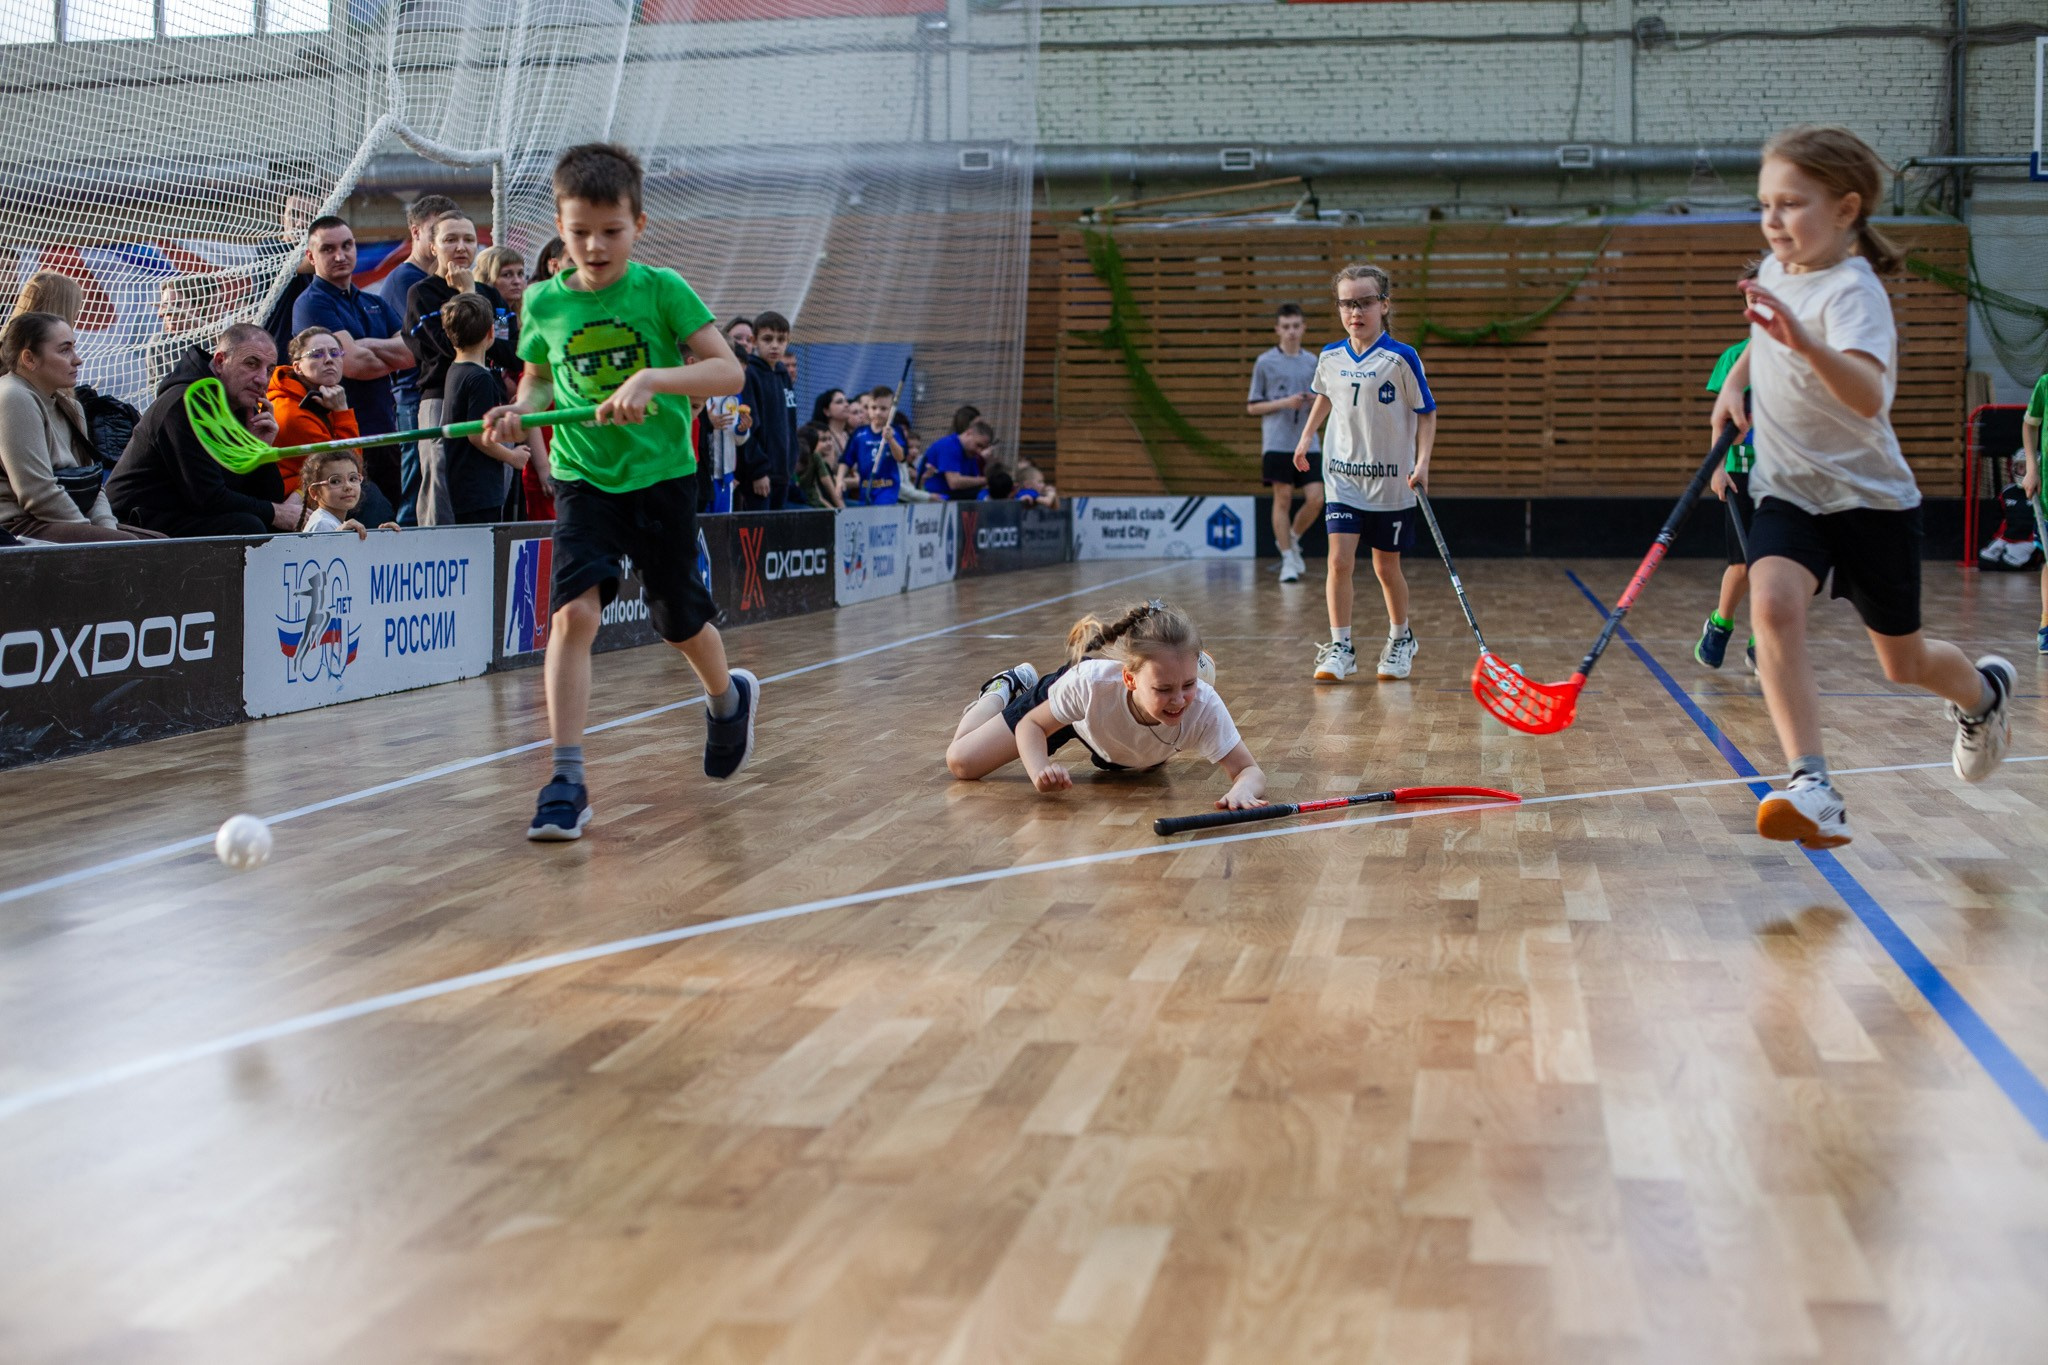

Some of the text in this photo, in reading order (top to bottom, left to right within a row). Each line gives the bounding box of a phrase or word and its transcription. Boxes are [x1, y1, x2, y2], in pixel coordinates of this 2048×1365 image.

[1340, 370, 1376, 378] GIVOVA
[1351, 382, 1360, 406] 7
[1139, 507, 1165, 520] club
[1102, 525, 1151, 541] Nord City
[1392, 520, 1402, 546] 7
[765, 548, 826, 580] OXDOG
[371, 558, 469, 605] МИНСПОРТ
[336, 596, 353, 615] ЛЕТ
[599, 586, 651, 626] afloorb
[385, 610, 455, 658] РОССИИ
[0, 611, 215, 689] OXDOG
